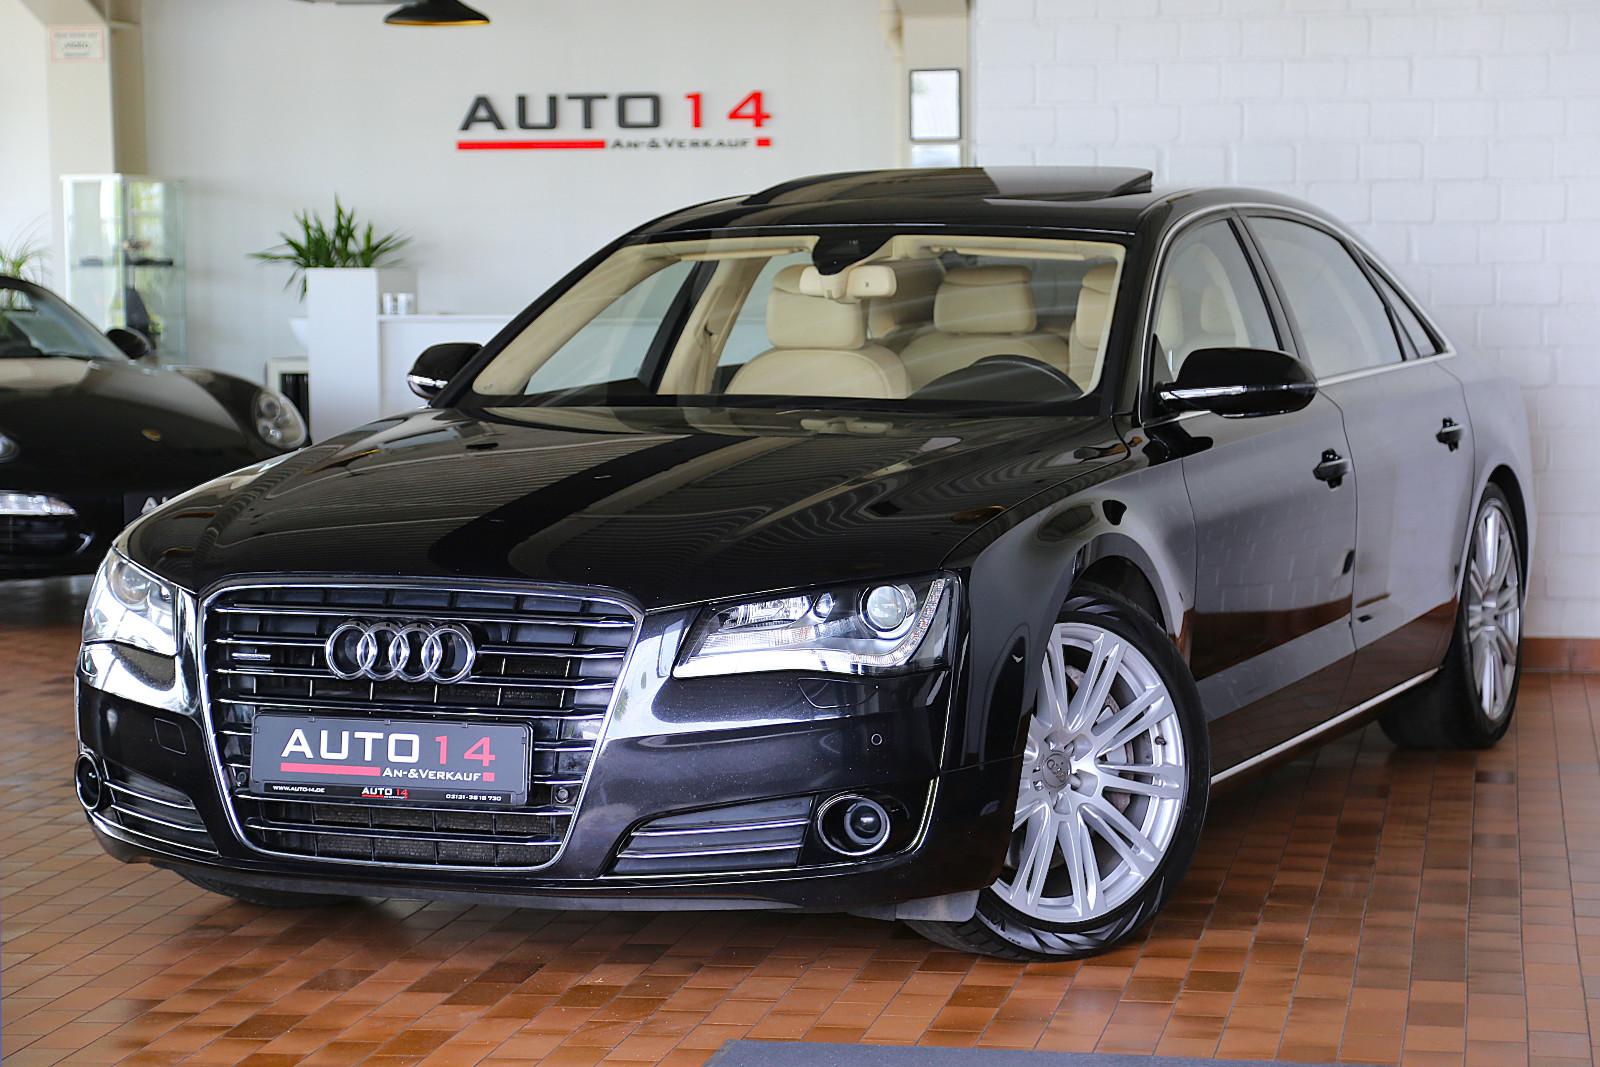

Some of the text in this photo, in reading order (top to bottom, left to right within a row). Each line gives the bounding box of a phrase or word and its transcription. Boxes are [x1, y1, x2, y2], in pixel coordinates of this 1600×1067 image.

[458, 90, 771, 131] AUTO 14
[280, 728, 497, 767] AUTO 14
[361, 786, 393, 796] AUTO
